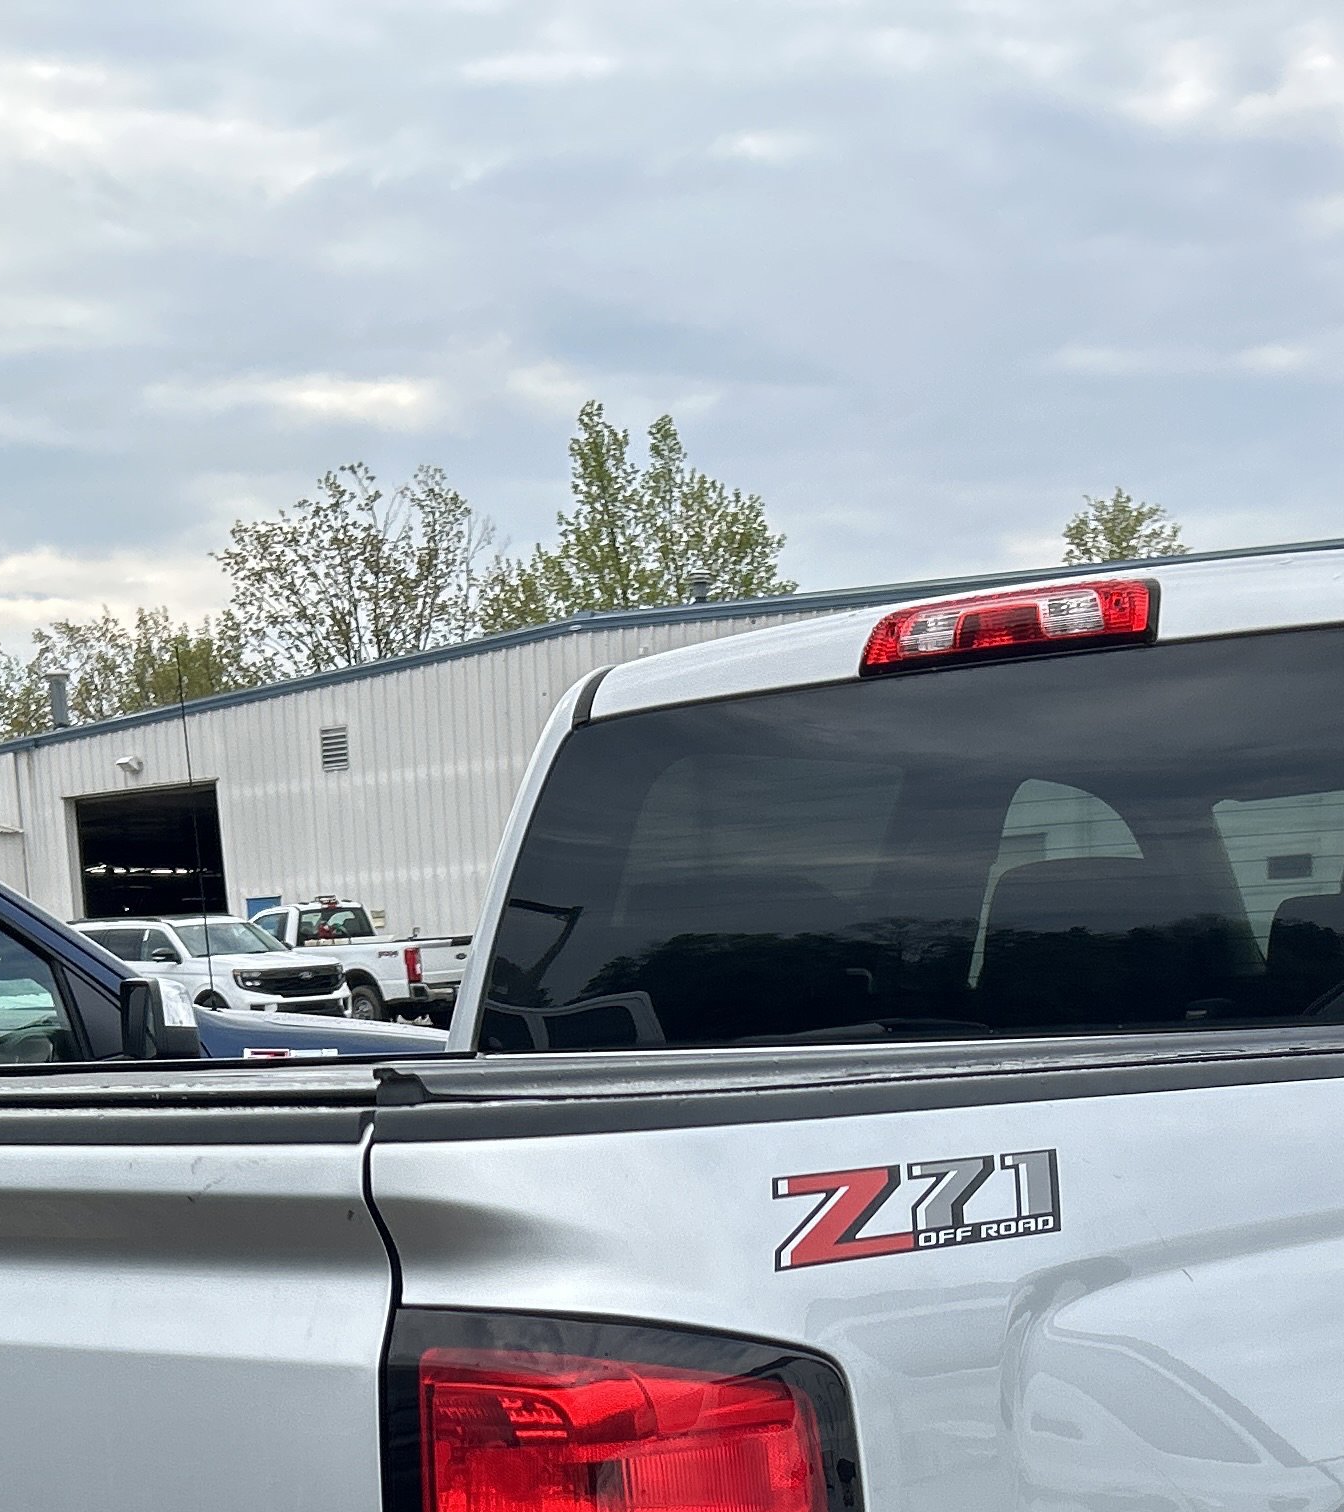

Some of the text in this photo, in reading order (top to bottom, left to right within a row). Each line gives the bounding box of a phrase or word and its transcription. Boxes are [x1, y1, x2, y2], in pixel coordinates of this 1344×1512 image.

[772, 1149, 1060, 1272] Z71
[918, 1215, 1054, 1247] OFF ROAD
